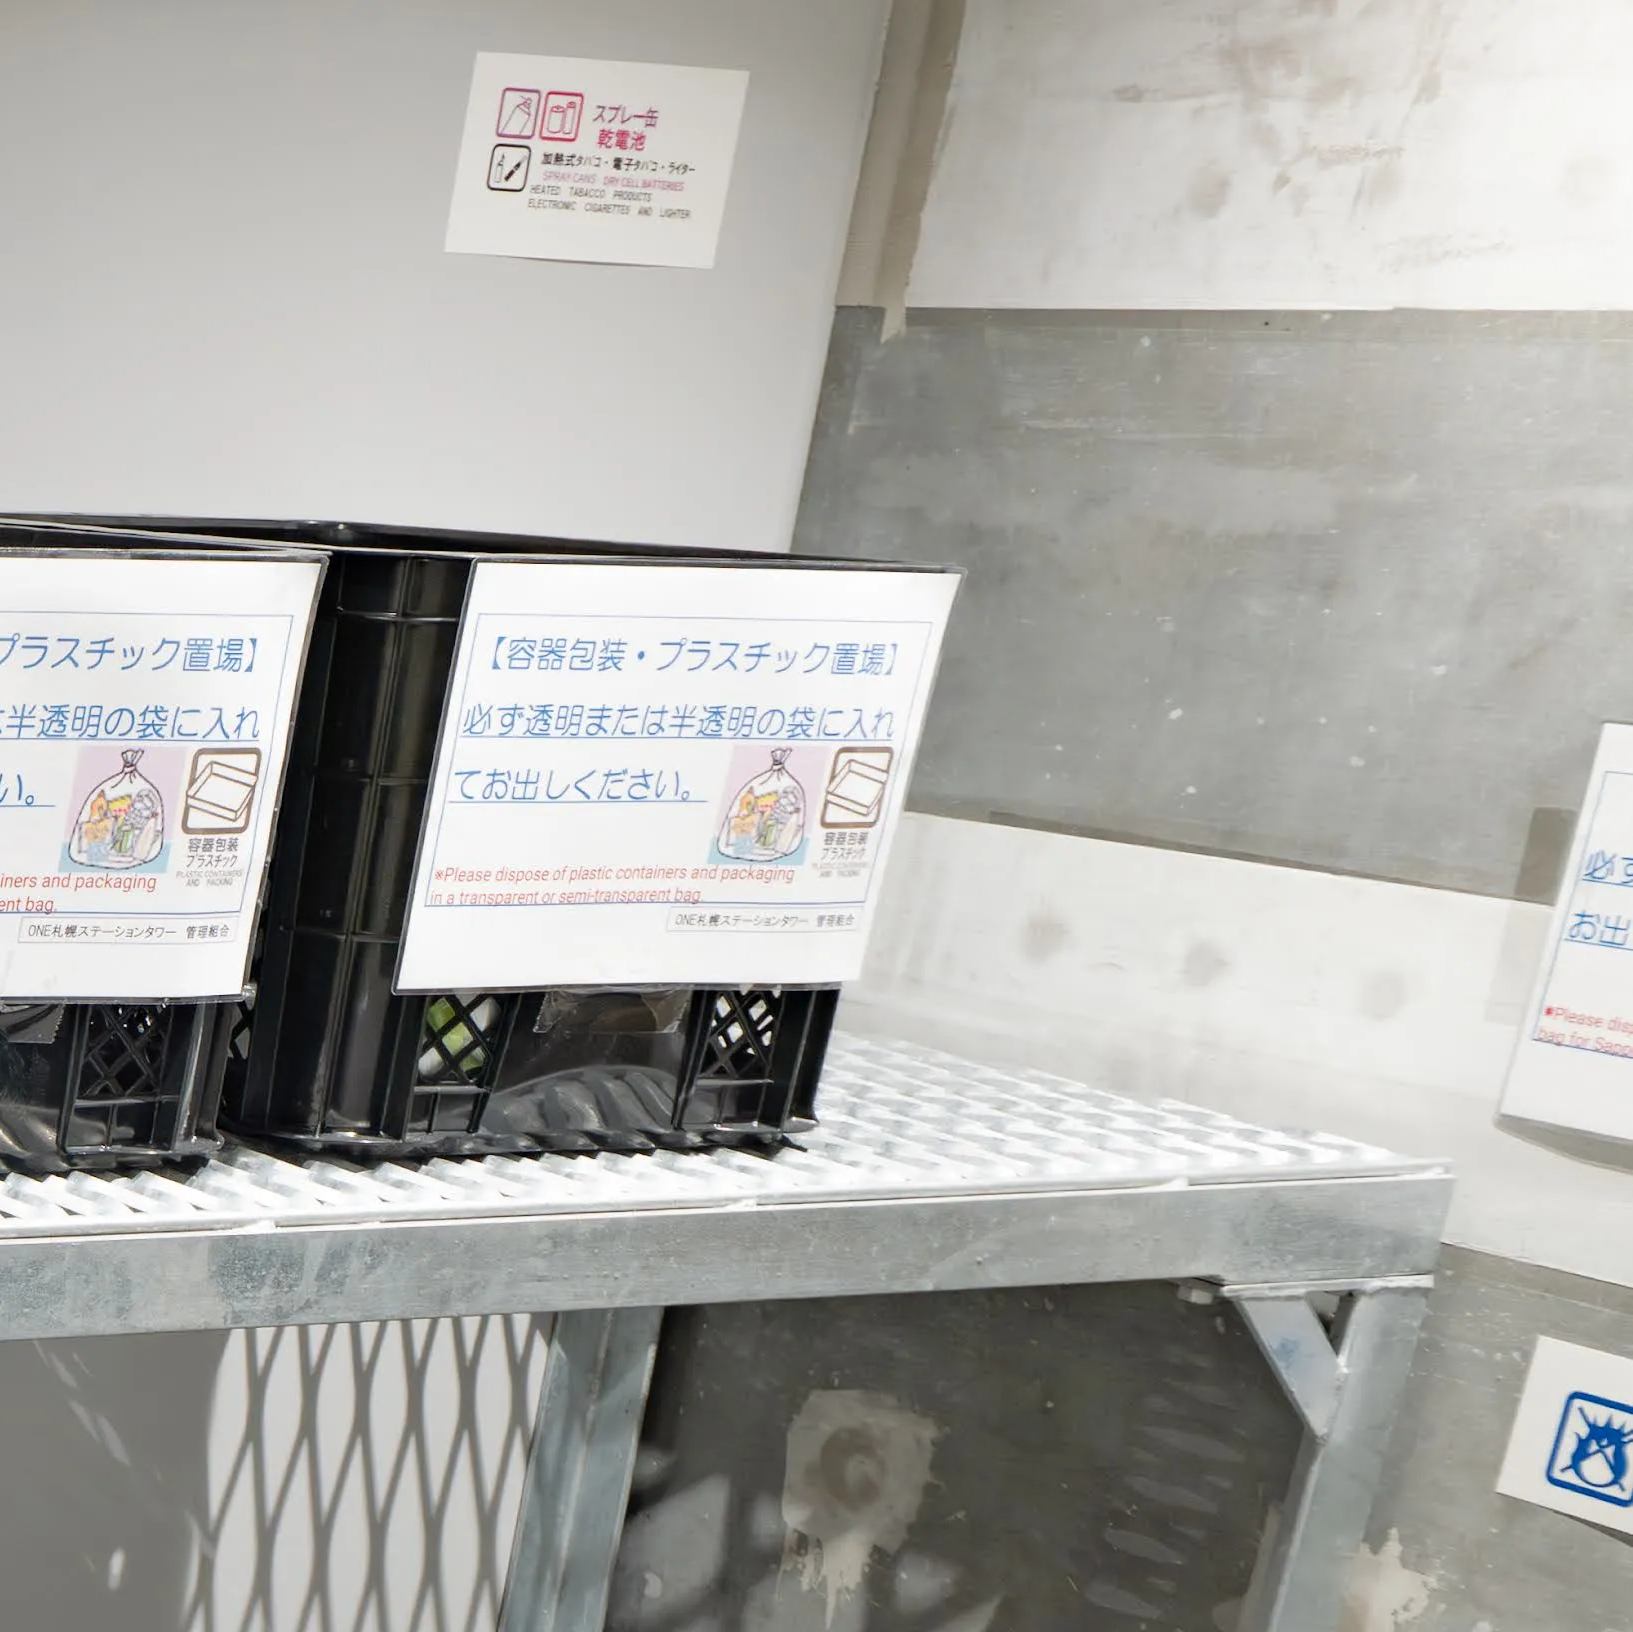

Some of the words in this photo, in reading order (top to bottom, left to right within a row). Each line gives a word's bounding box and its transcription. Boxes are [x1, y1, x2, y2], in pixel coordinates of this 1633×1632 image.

[593, 104, 659, 128] スプレー缶
[597, 129, 646, 151] 乾電池
[492, 636, 898, 676] 【容器包装・プラスチック置場】
[463, 704, 894, 738] 必ず透明または半透明の袋に入れ
[454, 767, 690, 801] てお出しください。
[188, 837, 239, 852] 容器包装
[186, 854, 238, 869] プラスチック
[28, 924, 177, 938] ONE札幌ステーションタワー
[186, 924, 230, 939] 管理組合
